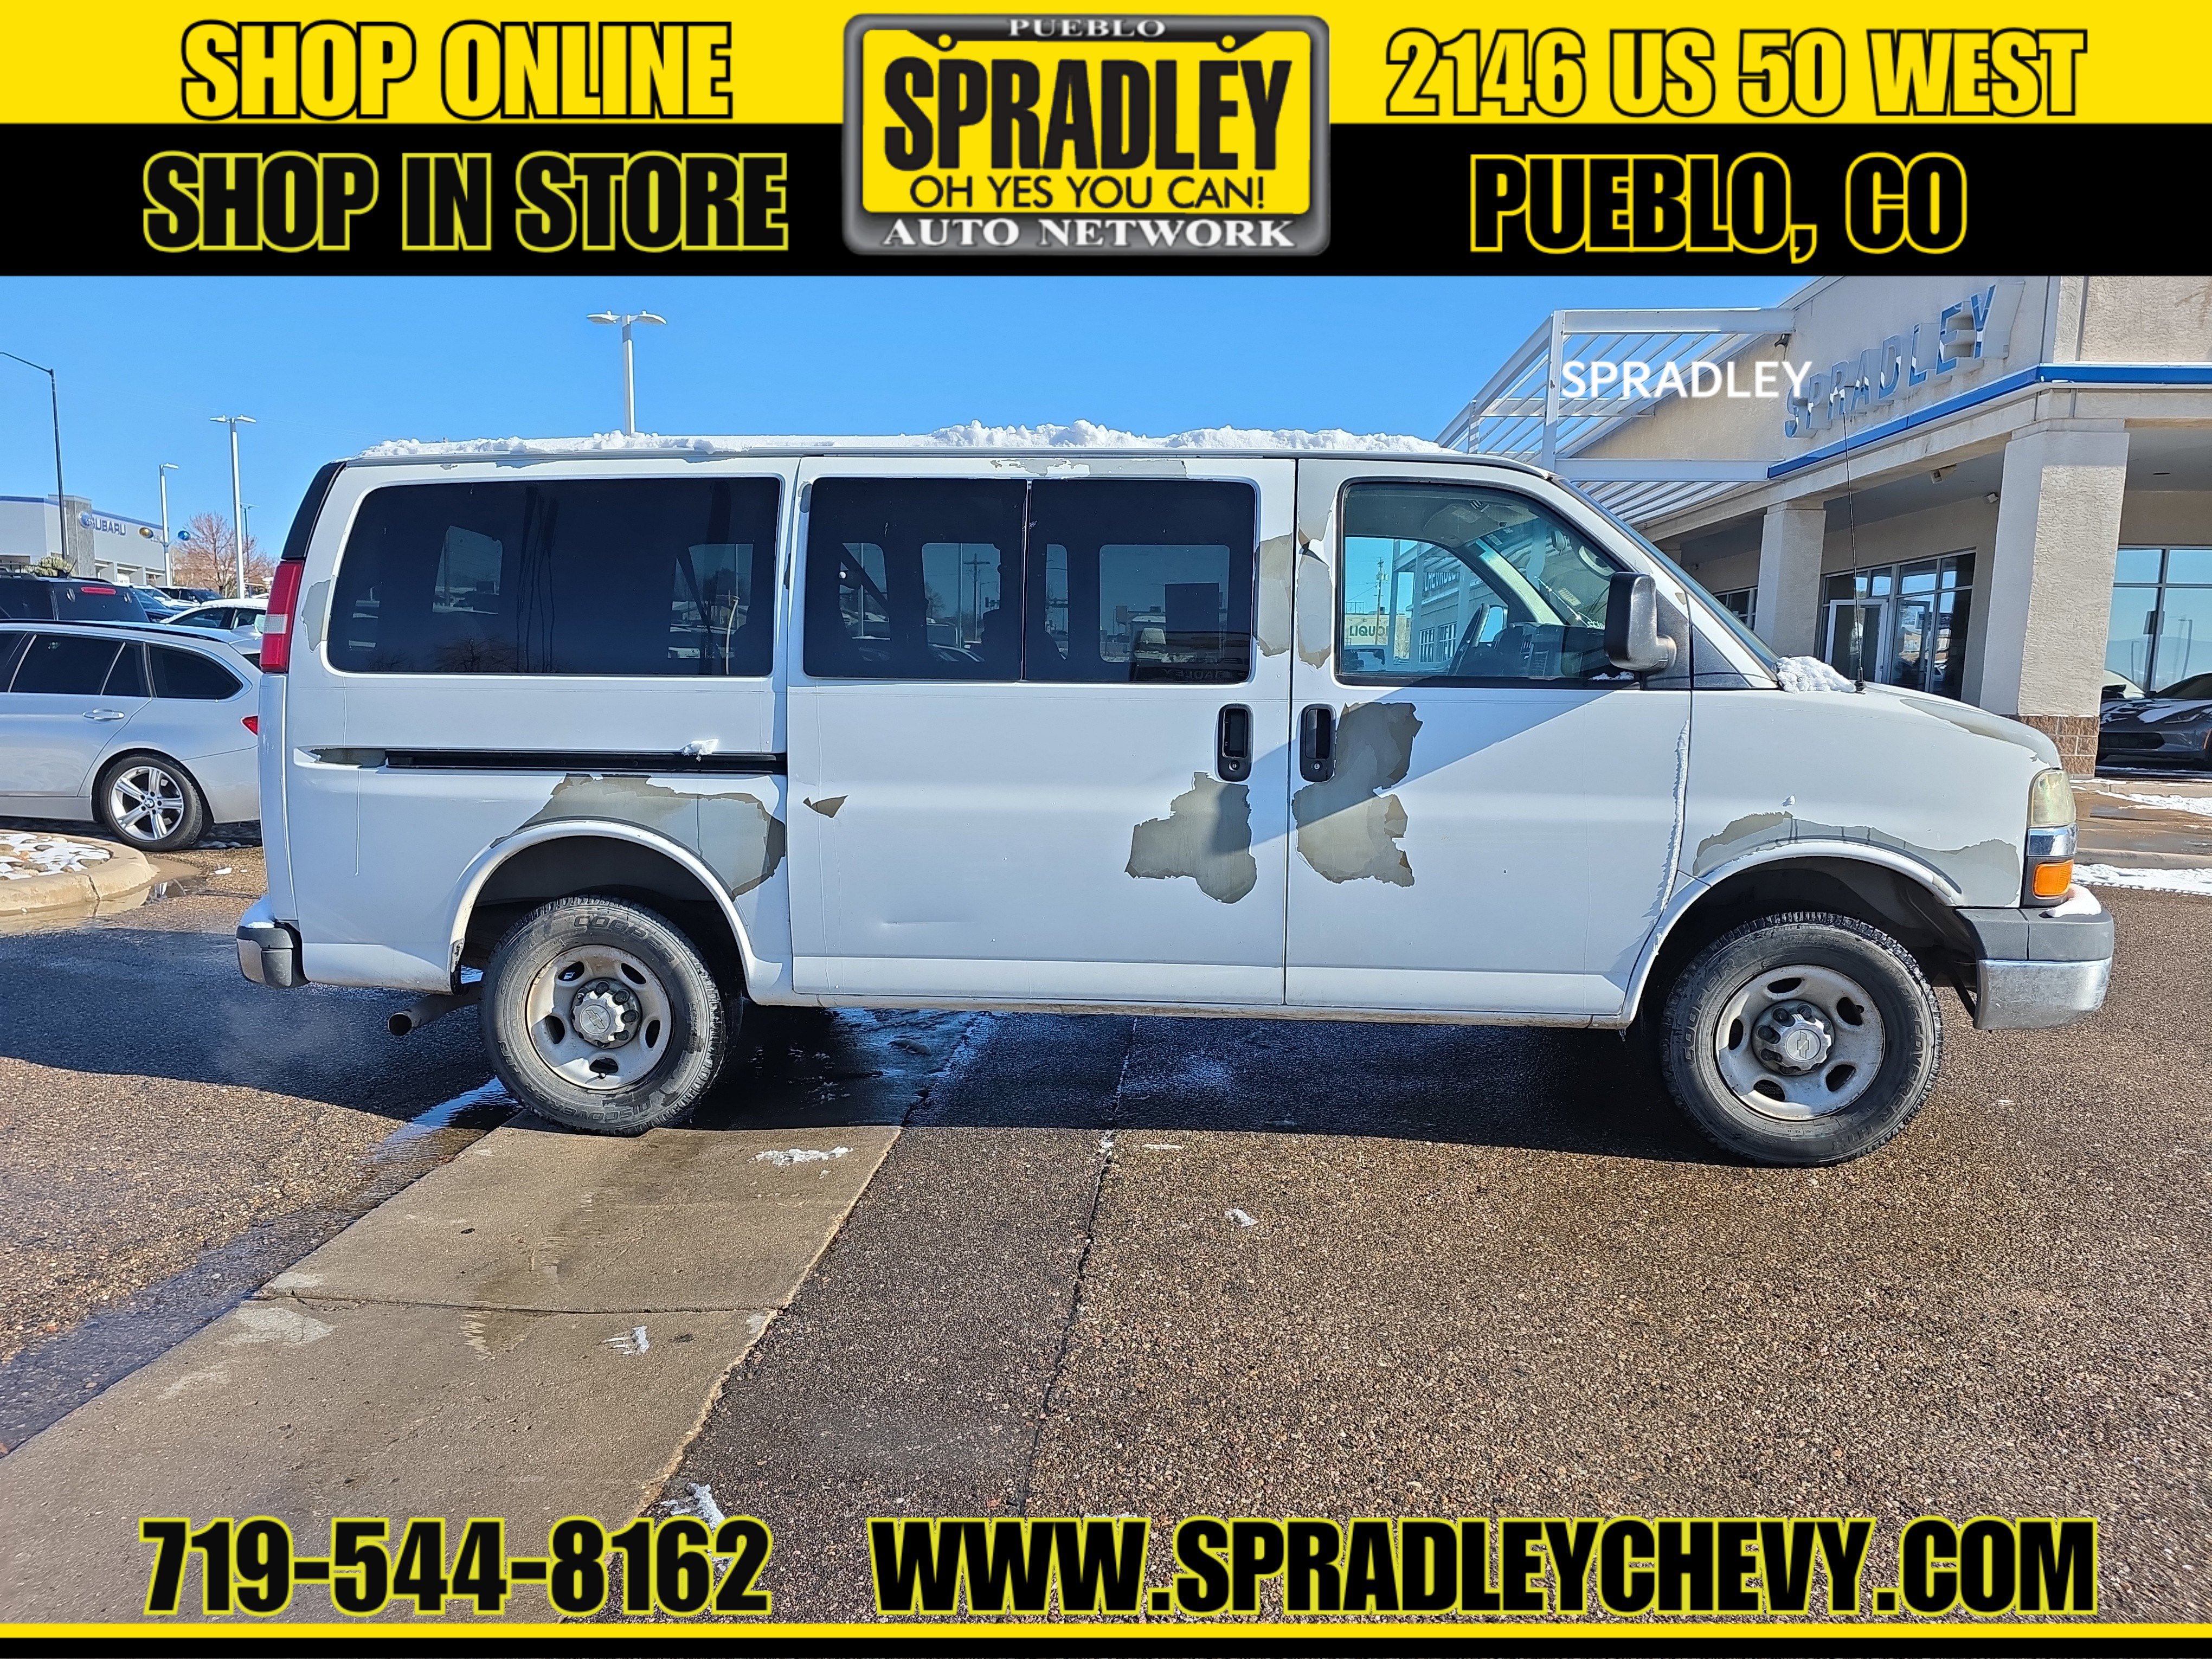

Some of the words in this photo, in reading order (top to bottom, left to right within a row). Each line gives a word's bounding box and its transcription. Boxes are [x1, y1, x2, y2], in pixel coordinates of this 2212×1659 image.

[1785, 284, 1997, 438] SPRADLEY
[1349, 625, 1388, 637] LIQUO
[574, 915, 676, 964] COOPER
[1682, 957, 1738, 1065] COOPER
[1880, 984, 1925, 1123] DISCOVERER
[526, 1082, 651, 1122] DISCOVERER
